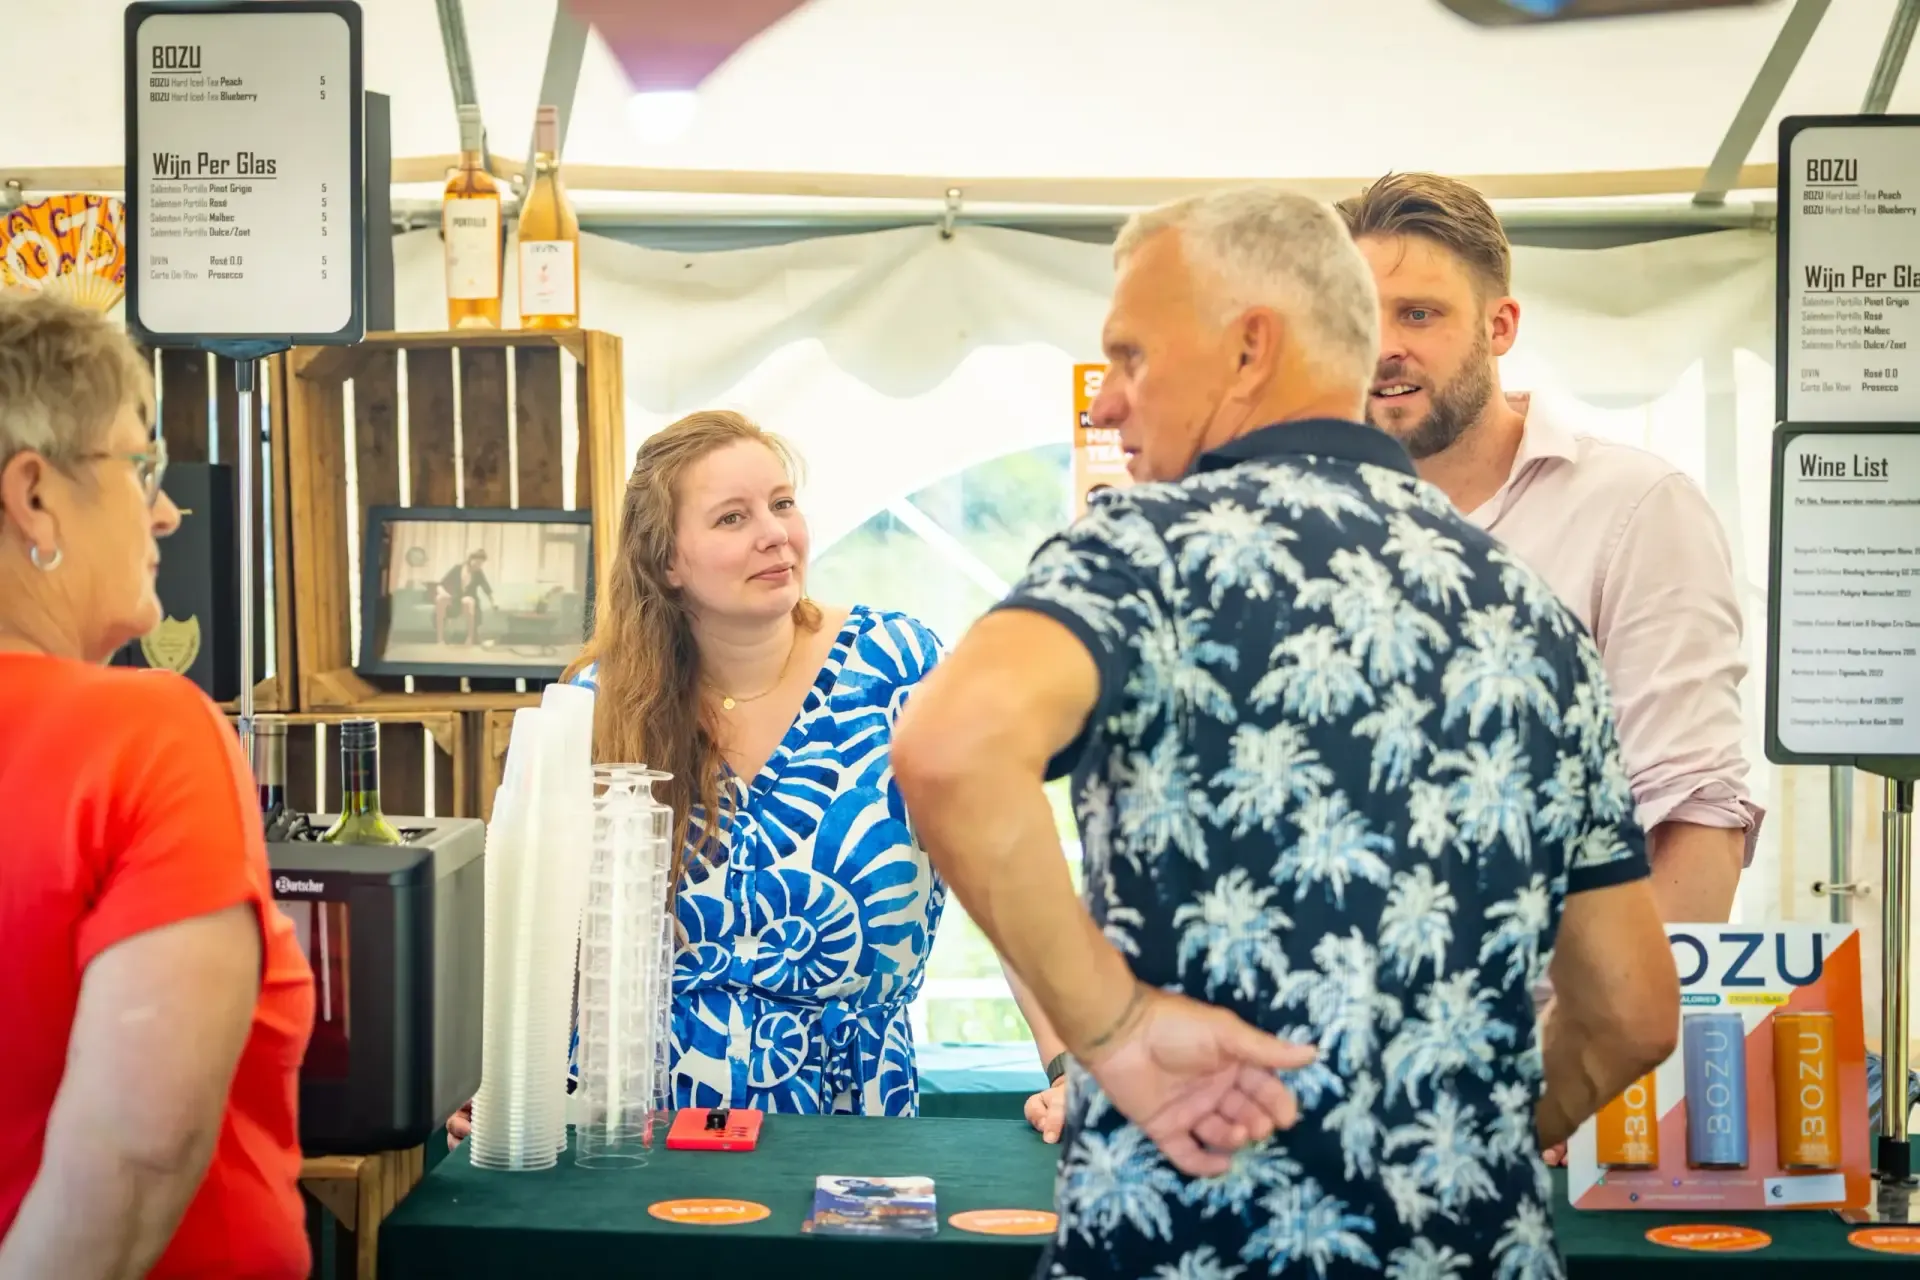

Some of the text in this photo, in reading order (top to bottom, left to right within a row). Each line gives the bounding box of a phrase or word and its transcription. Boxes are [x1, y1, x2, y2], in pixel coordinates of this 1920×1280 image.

[152, 45, 201, 69] BOZU
[150, 77, 170, 87] BOZU
[220, 76, 243, 86] Peach
[320, 76, 326, 86] 5
[150, 92, 170, 102] BOZU
[220, 91, 258, 102] Blueberry
[320, 91, 326, 100] 5
[153, 152, 277, 179] Wijn Per Glas
[1806, 159, 1858, 182] BOZU
[209, 183, 228, 193] Pinot
[229, 183, 253, 195] Grigio
[321, 183, 327, 193] 5
[1803, 190, 1824, 200] BOZU
[1878, 189, 1902, 200] Peach
[209, 198, 228, 208] Rosé
[321, 198, 327, 208] 5
[1803, 204, 1824, 215] BOZU
[1878, 204, 1917, 216] Blueberry
[209, 213, 235, 223] Malbec
[321, 212, 327, 222] 5
[321, 227, 327, 237] 5
[210, 255, 228, 265] Rosé
[321, 255, 327, 265] 5
[208, 270, 244, 280] Prosecco
[321, 270, 327, 280] 5
[1805, 265, 1845, 292] Wijn
[1852, 265, 1887, 288] Per
[1864, 297, 1884, 307] Pinot
[1886, 296, 1910, 308] Grigio
[1864, 311, 1883, 321] Rosé
[1864, 325, 1891, 335] Malbec
[1864, 368, 1883, 379] Rosé
[1862, 382, 1899, 392] Prosecco
[1800, 453, 1889, 477] Wine List
[1669, 932, 1824, 987] OZU
[1681, 995, 1717, 1004] ALORIES
[1704, 1030, 1732, 1134] BOZU
[1798, 1031, 1825, 1136] BOZU
[1624, 1074, 1648, 1136] BO
